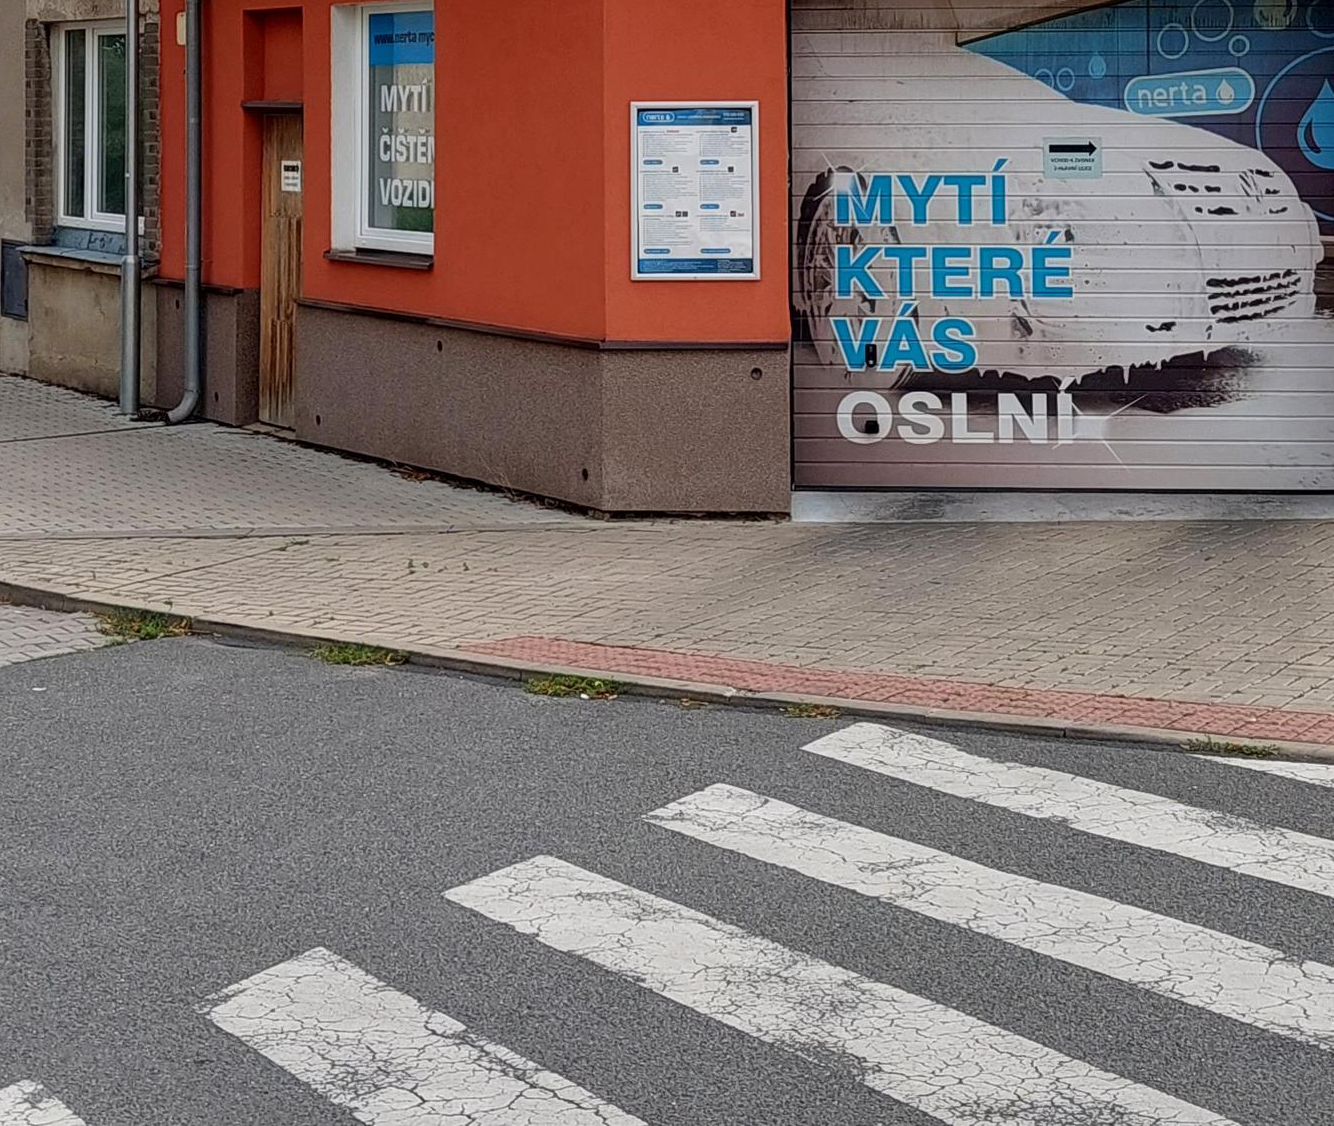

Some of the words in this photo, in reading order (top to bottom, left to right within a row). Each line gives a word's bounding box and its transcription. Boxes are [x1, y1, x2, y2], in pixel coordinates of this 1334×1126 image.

[380, 78, 428, 113] MYTÍ
[1137, 81, 1207, 109] nerta
[833, 157, 1009, 227] MYTÍ
[834, 229, 1075, 300] KTERÉ
[830, 300, 979, 373] VÁS
[836, 376, 1076, 445] OSLNÍ
